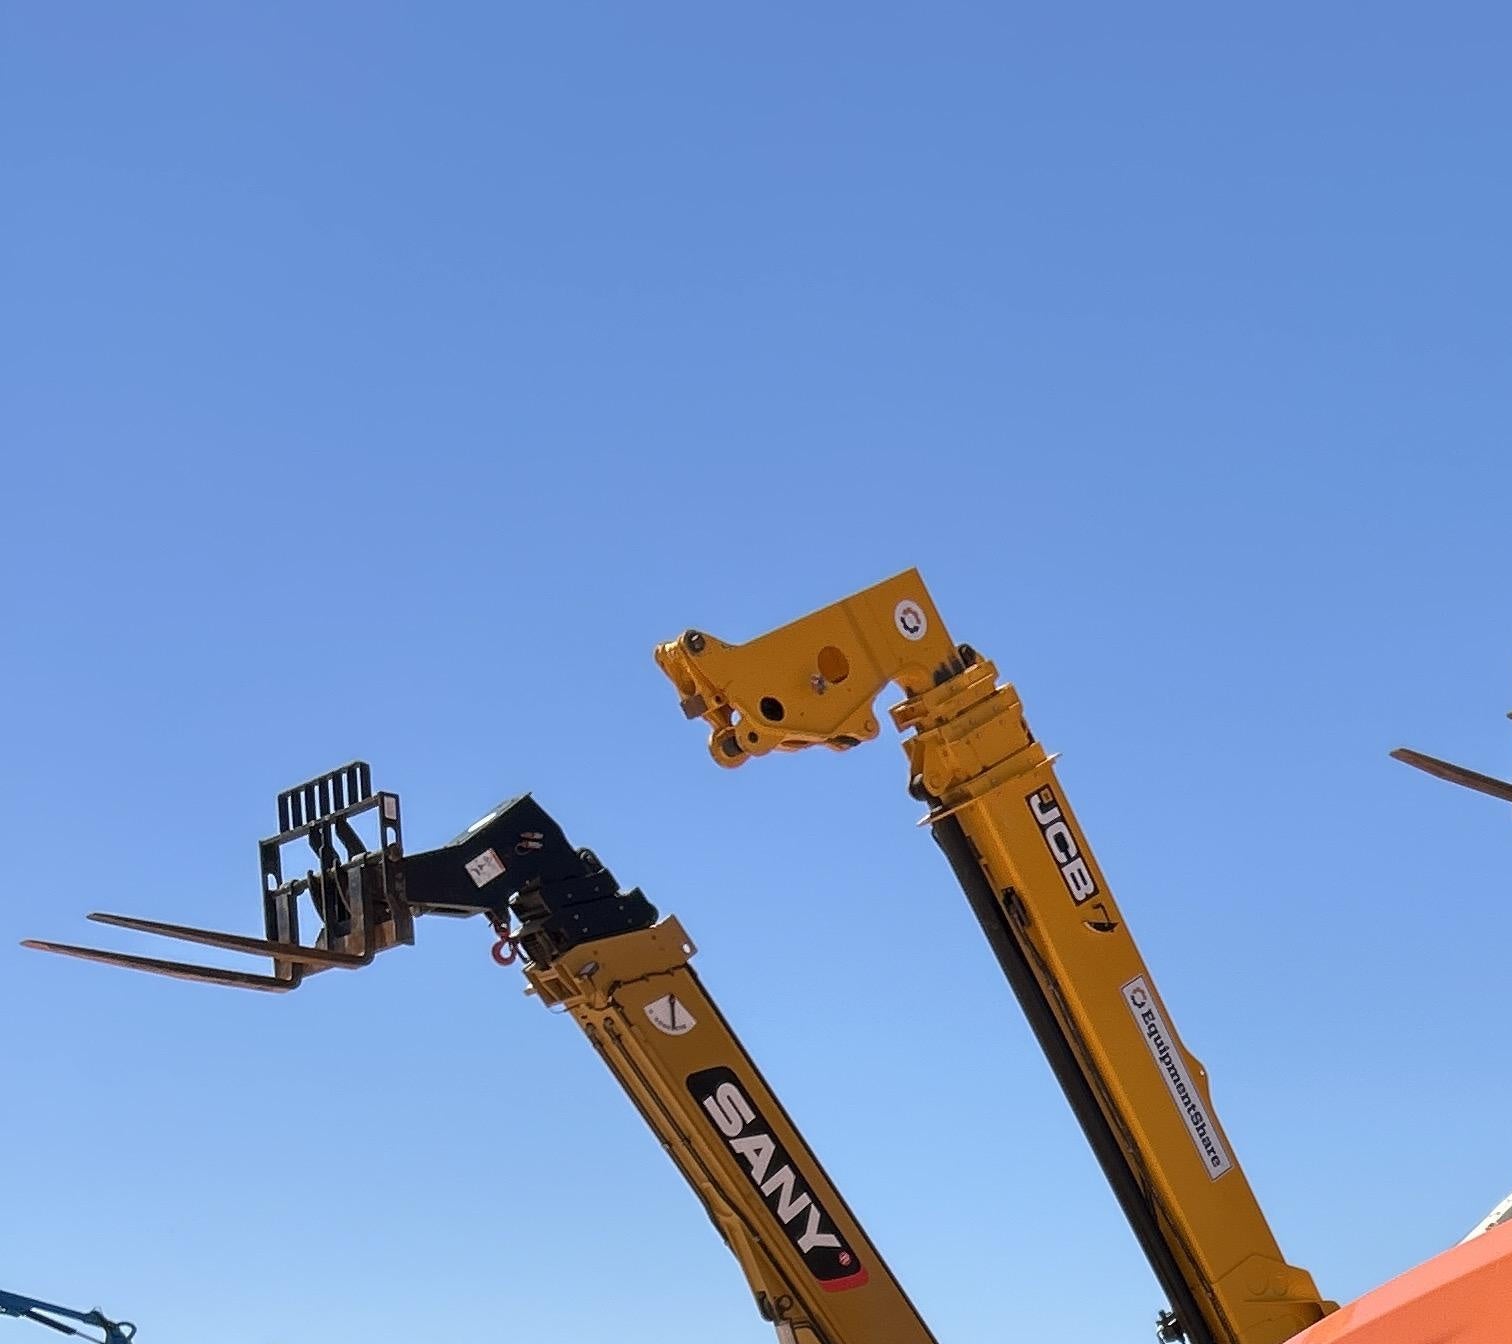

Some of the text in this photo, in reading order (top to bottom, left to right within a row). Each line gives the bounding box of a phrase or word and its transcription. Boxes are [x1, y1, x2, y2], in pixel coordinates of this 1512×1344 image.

[1029, 791, 1095, 902] JCB
[703, 1081, 843, 1254] SANY
[1141, 1008, 1221, 1169] EquipmentShare
